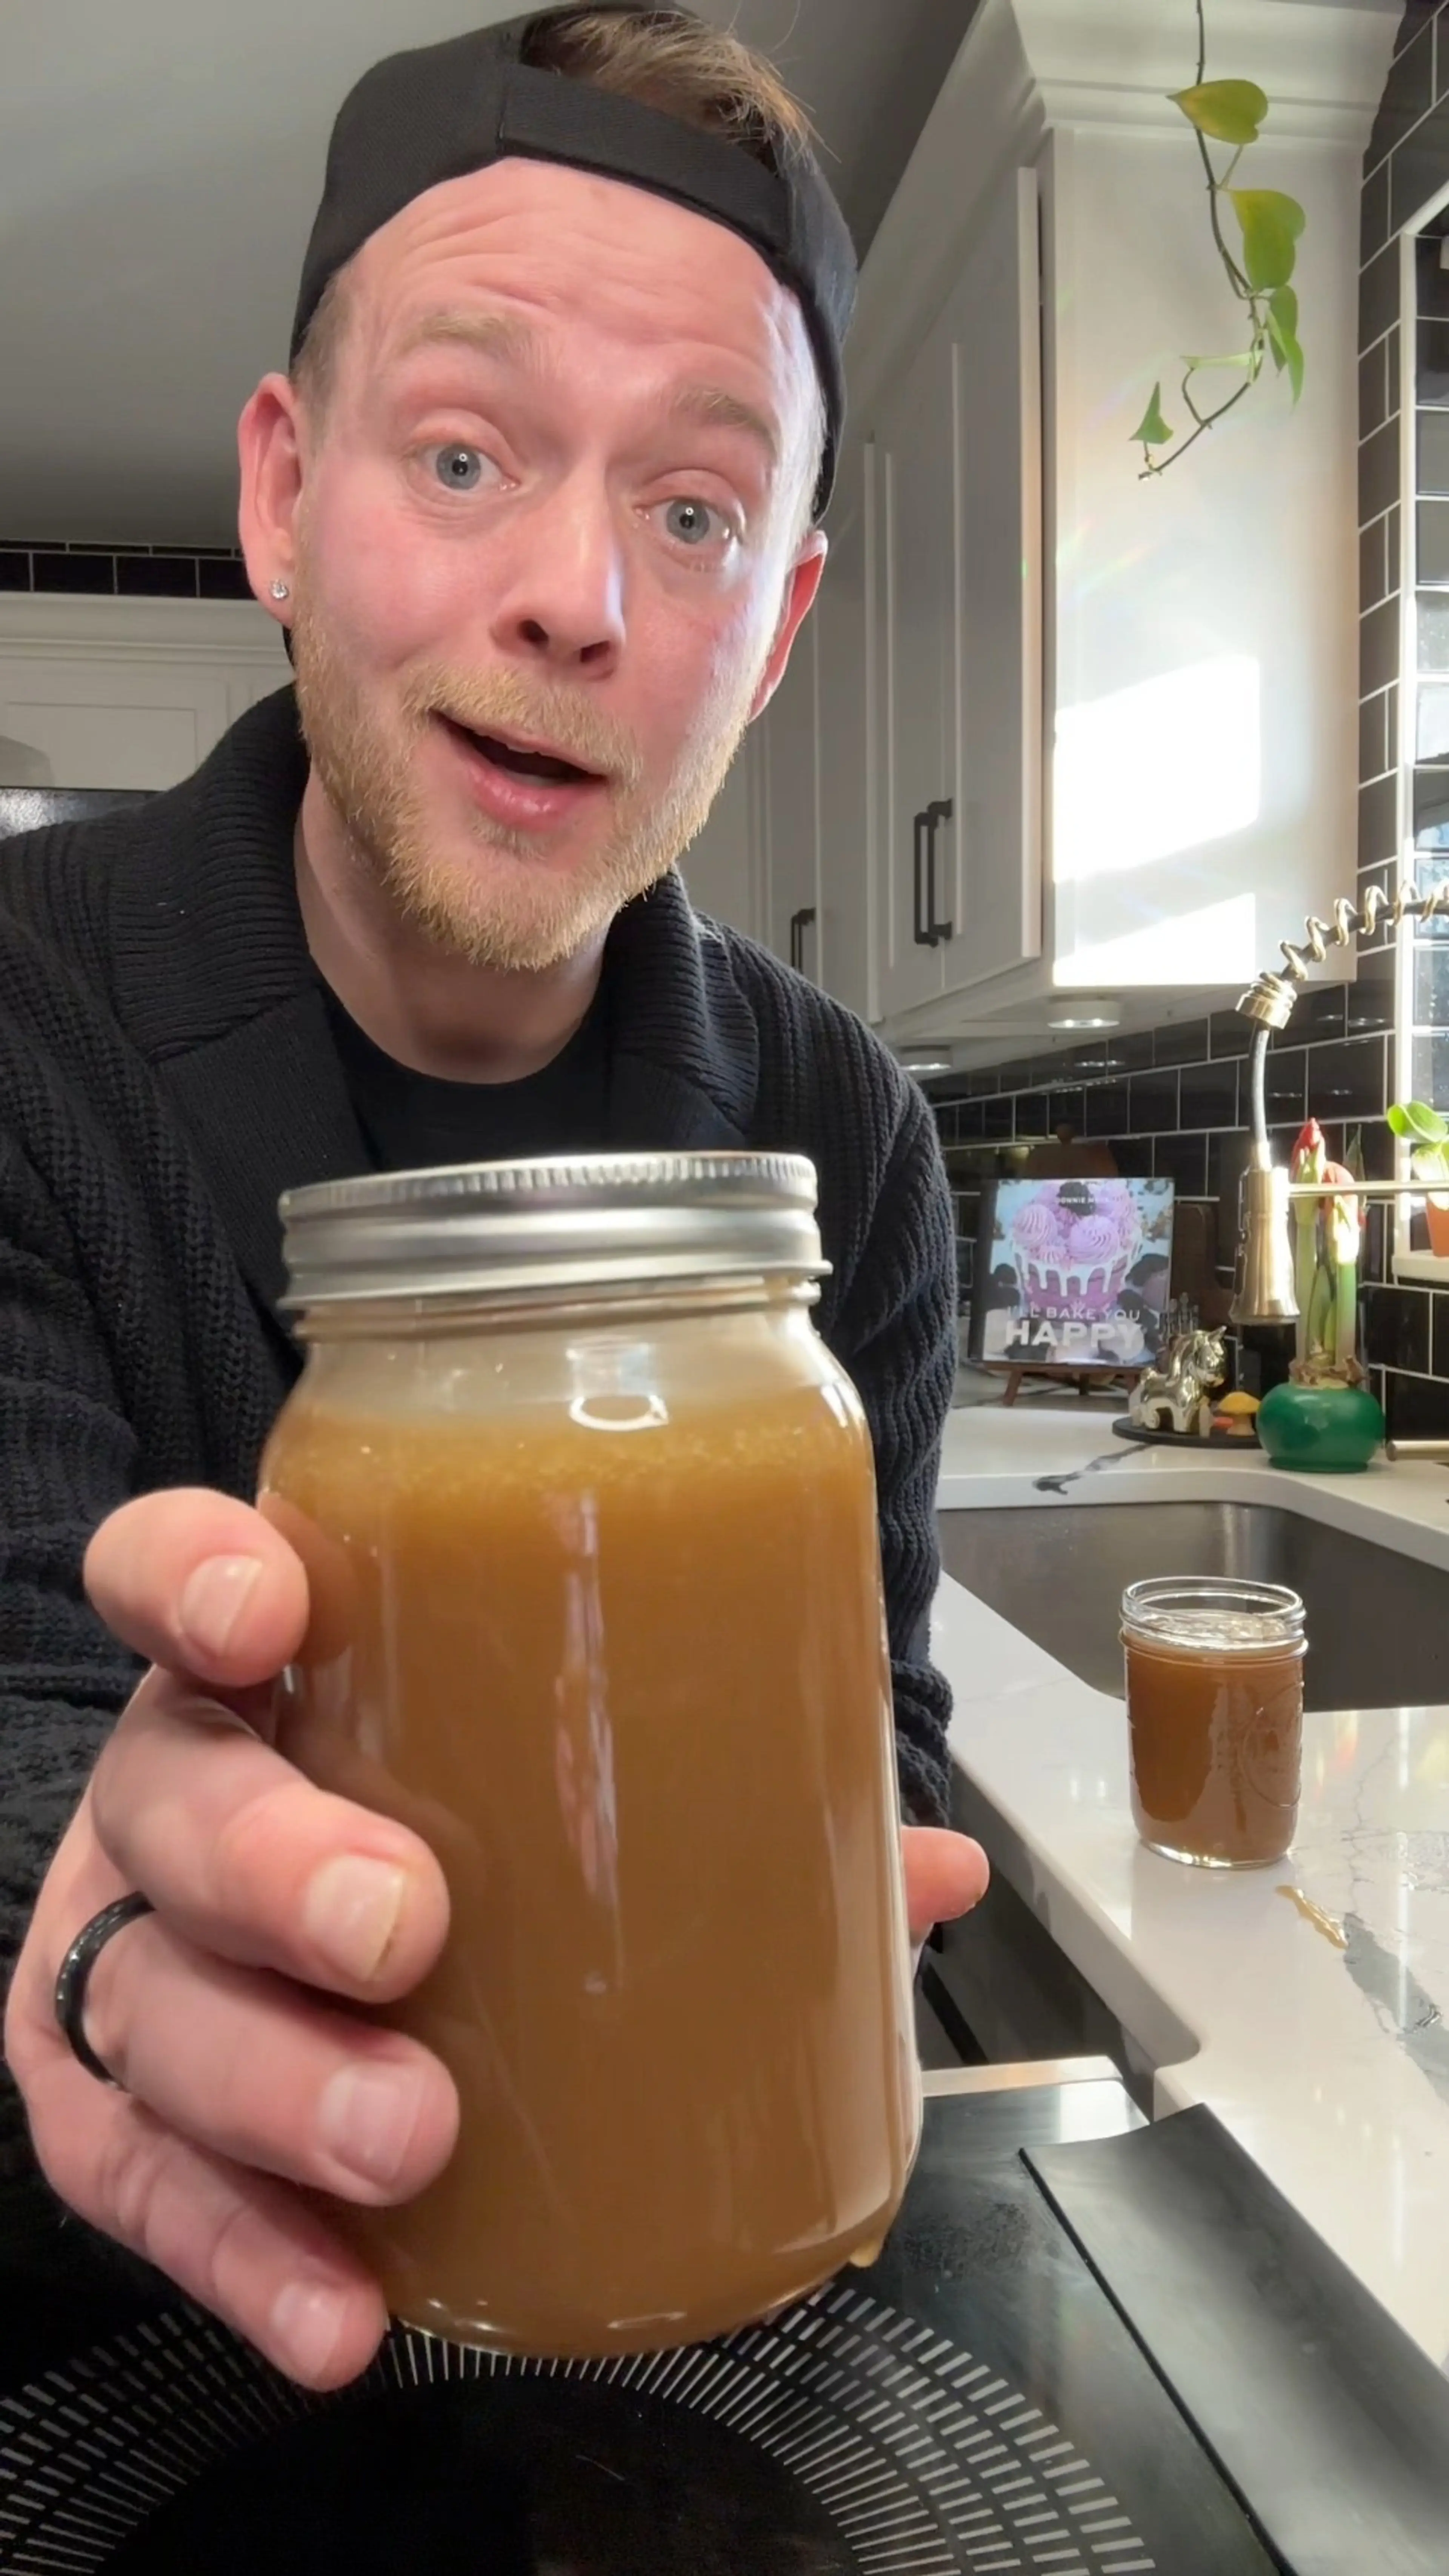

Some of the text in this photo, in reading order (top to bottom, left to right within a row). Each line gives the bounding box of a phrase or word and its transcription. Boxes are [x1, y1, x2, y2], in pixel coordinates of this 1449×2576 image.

[1046, 1306, 1096, 1320] BAKE
[1103, 1306, 1140, 1321] YOU
[1006, 1320, 1142, 1349] HAPPY
